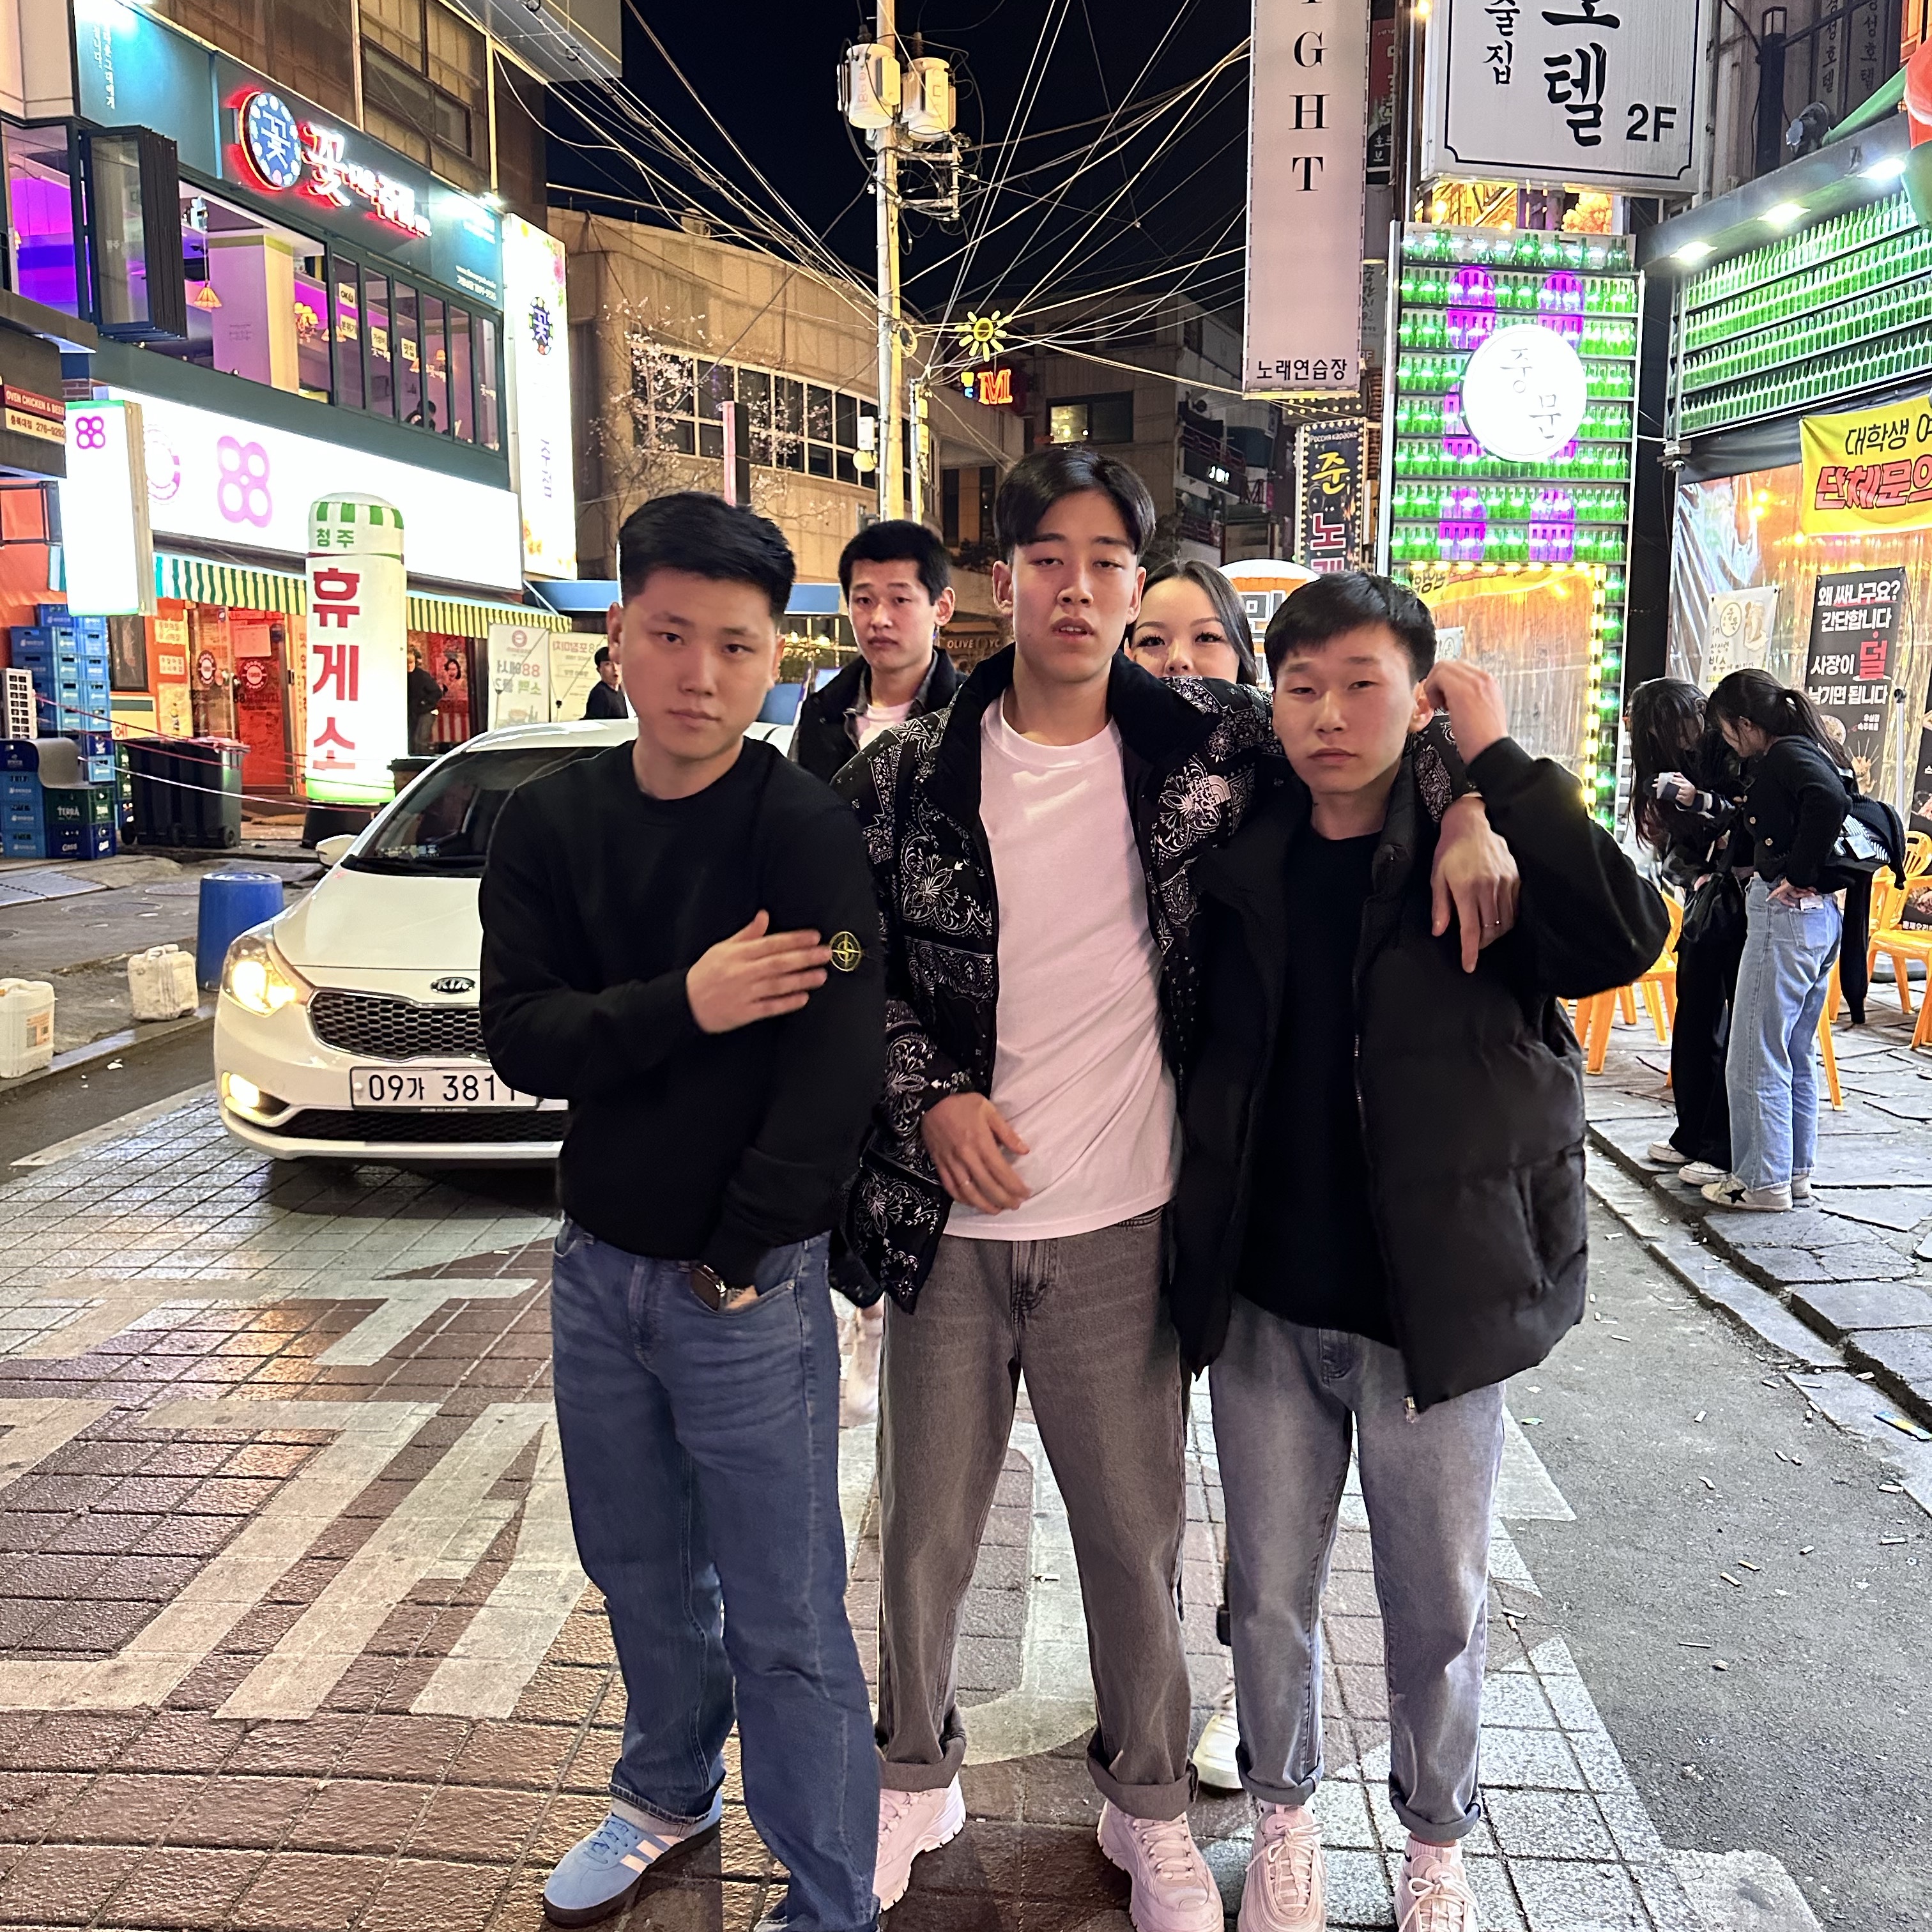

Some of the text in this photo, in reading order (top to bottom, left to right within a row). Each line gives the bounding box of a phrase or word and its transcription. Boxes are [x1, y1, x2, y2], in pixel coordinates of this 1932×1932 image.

[1288, 0, 1330, 191] GHT
[1626, 103, 1676, 142] 2F
[1257, 359, 1347, 381] 노래연습장
[6, 390, 22, 404] OVEN
[22, 395, 46, 411] CHICKEN
[1845, 418, 1910, 456] 대학생
[1310, 451, 1351, 495] 준
[316, 528, 354, 548] 청주
[1817, 585, 1834, 606] 왜
[1821, 608, 1892, 632] 간단합니다
[947, 640, 974, 648] OLIVE
[312, 567, 360, 771] 휴게소
[1810, 640, 1888, 680] 사장이 덜
[1848, 685, 1888, 705] 됩니다
[369, 1075, 425, 1101] 09가
